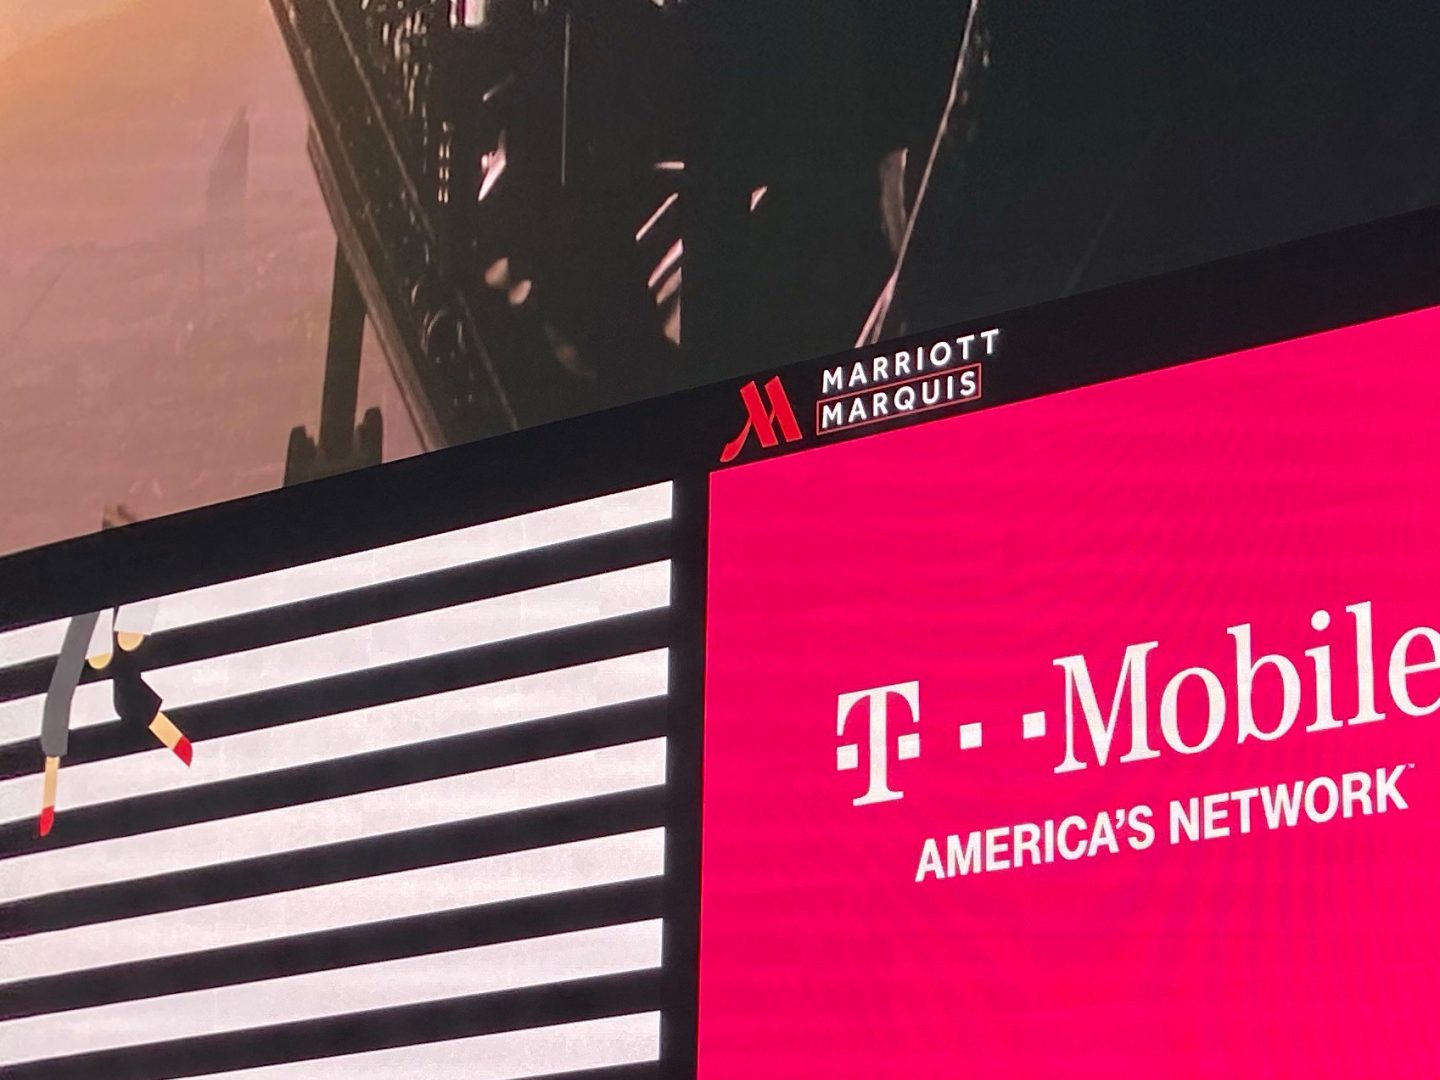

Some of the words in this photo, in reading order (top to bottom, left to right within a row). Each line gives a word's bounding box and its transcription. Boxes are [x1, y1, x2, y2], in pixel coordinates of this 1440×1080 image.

[822, 329, 999, 394] MARRIOTT
[821, 371, 977, 429] MARQUIS
[914, 803, 1155, 882] AMERICA'S
[1170, 763, 1409, 846] NETWORK
